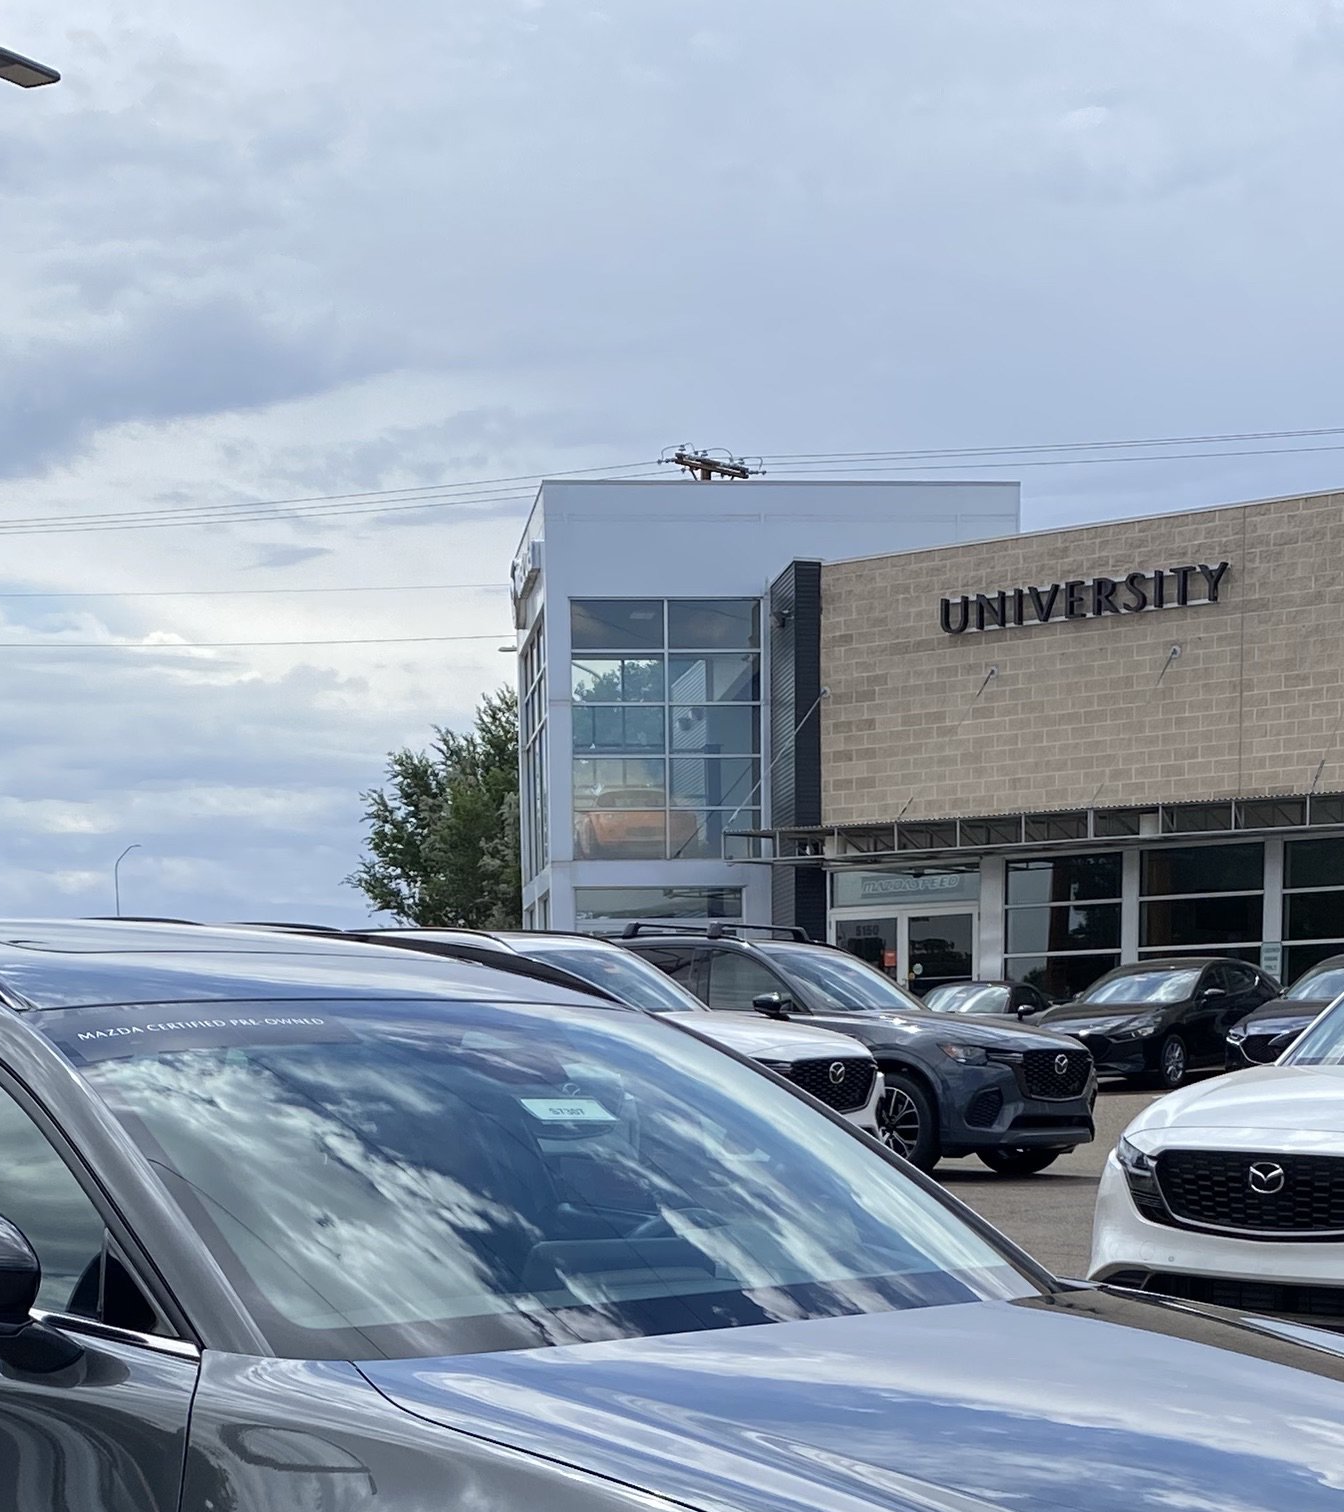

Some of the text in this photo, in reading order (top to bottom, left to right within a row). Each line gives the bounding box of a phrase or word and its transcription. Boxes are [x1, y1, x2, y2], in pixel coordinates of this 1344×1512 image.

[940, 561, 1229, 634] UNIVERSITY
[77, 1017, 325, 1041] MAZDA CERTIFIED PRE-OWNED
